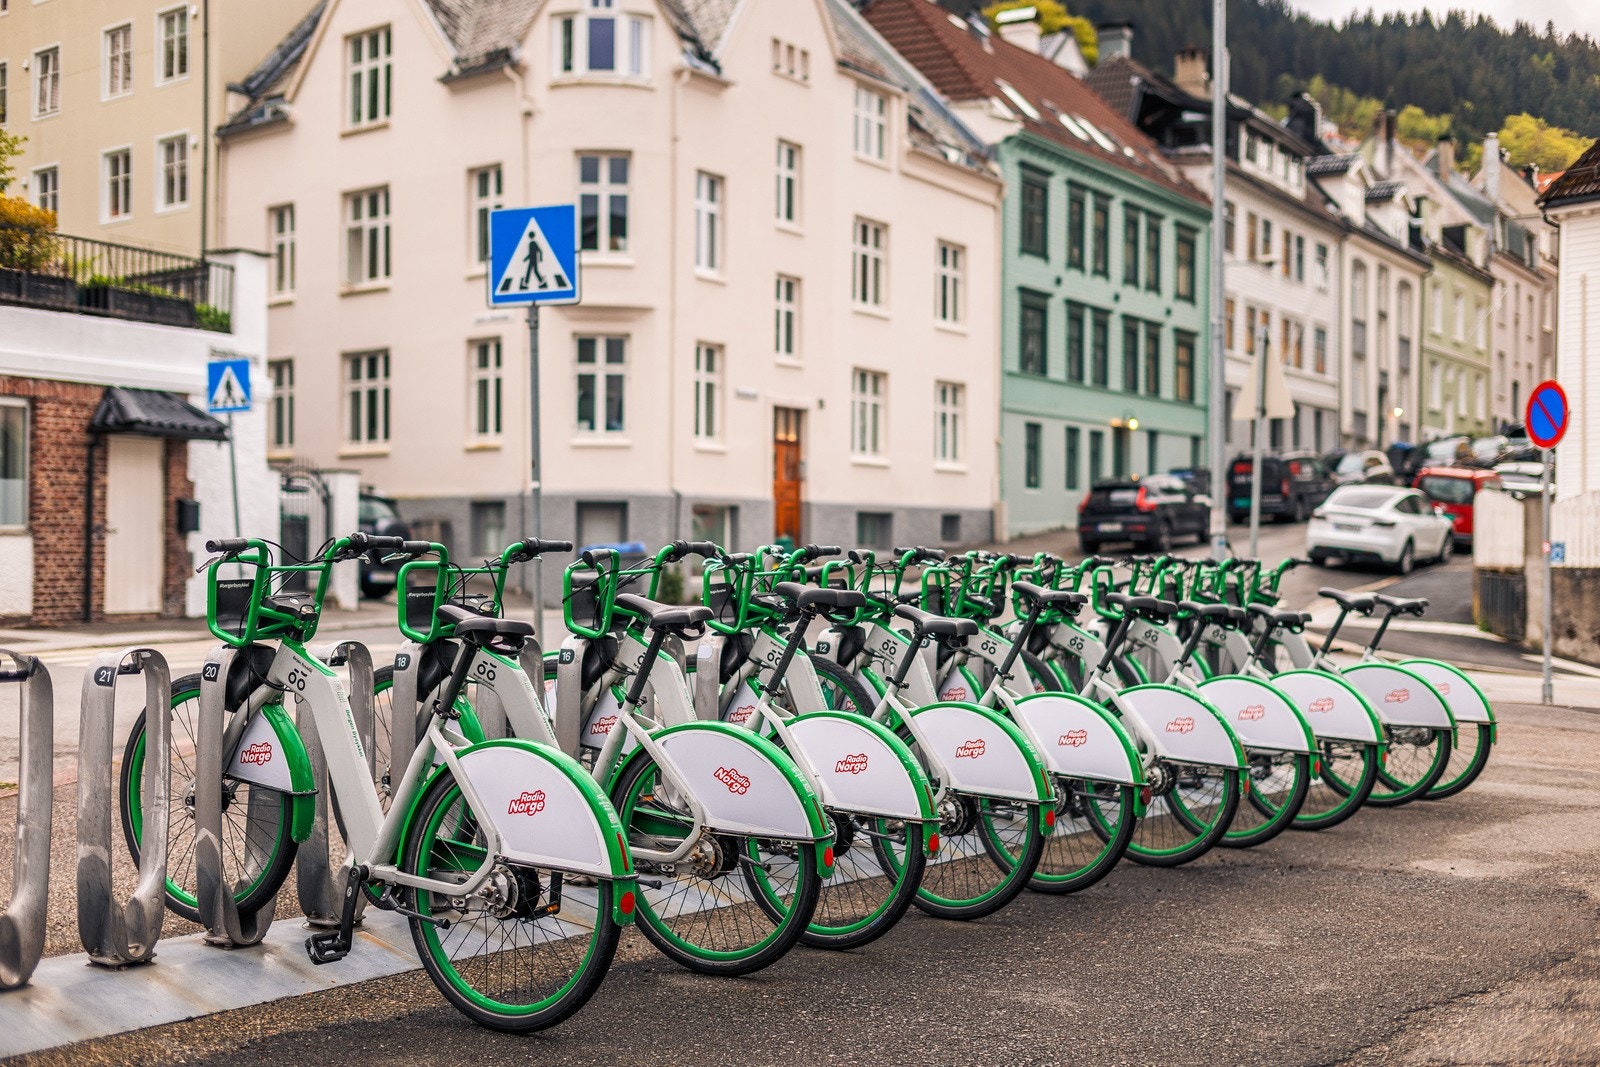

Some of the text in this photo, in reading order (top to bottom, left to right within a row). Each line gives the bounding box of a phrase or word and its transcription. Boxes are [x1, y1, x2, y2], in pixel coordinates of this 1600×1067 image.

[819, 643, 828, 653] 12
[397, 656, 407, 668] 18
[562, 651, 571, 662] 16
[99, 670, 112, 683] 21
[204, 666, 217, 678] 20
[345, 709, 355, 730] Bergen
[730, 712, 751, 723] Norg
[591, 723, 613, 735] Norg
[965, 739, 985, 748] Radio
[1058, 735, 1087, 747] Norge
[250, 743, 272, 753] Radio
[956, 746, 985, 758] Norge
[240, 750, 272, 766] Norge
[846, 754, 868, 763] Radio
[835, 760, 868, 774] Norge
[714, 767, 747, 795] Norge
[729, 768, 750, 788] Radio
[520, 790, 546, 802] Radio
[508, 799, 545, 816] Norge
